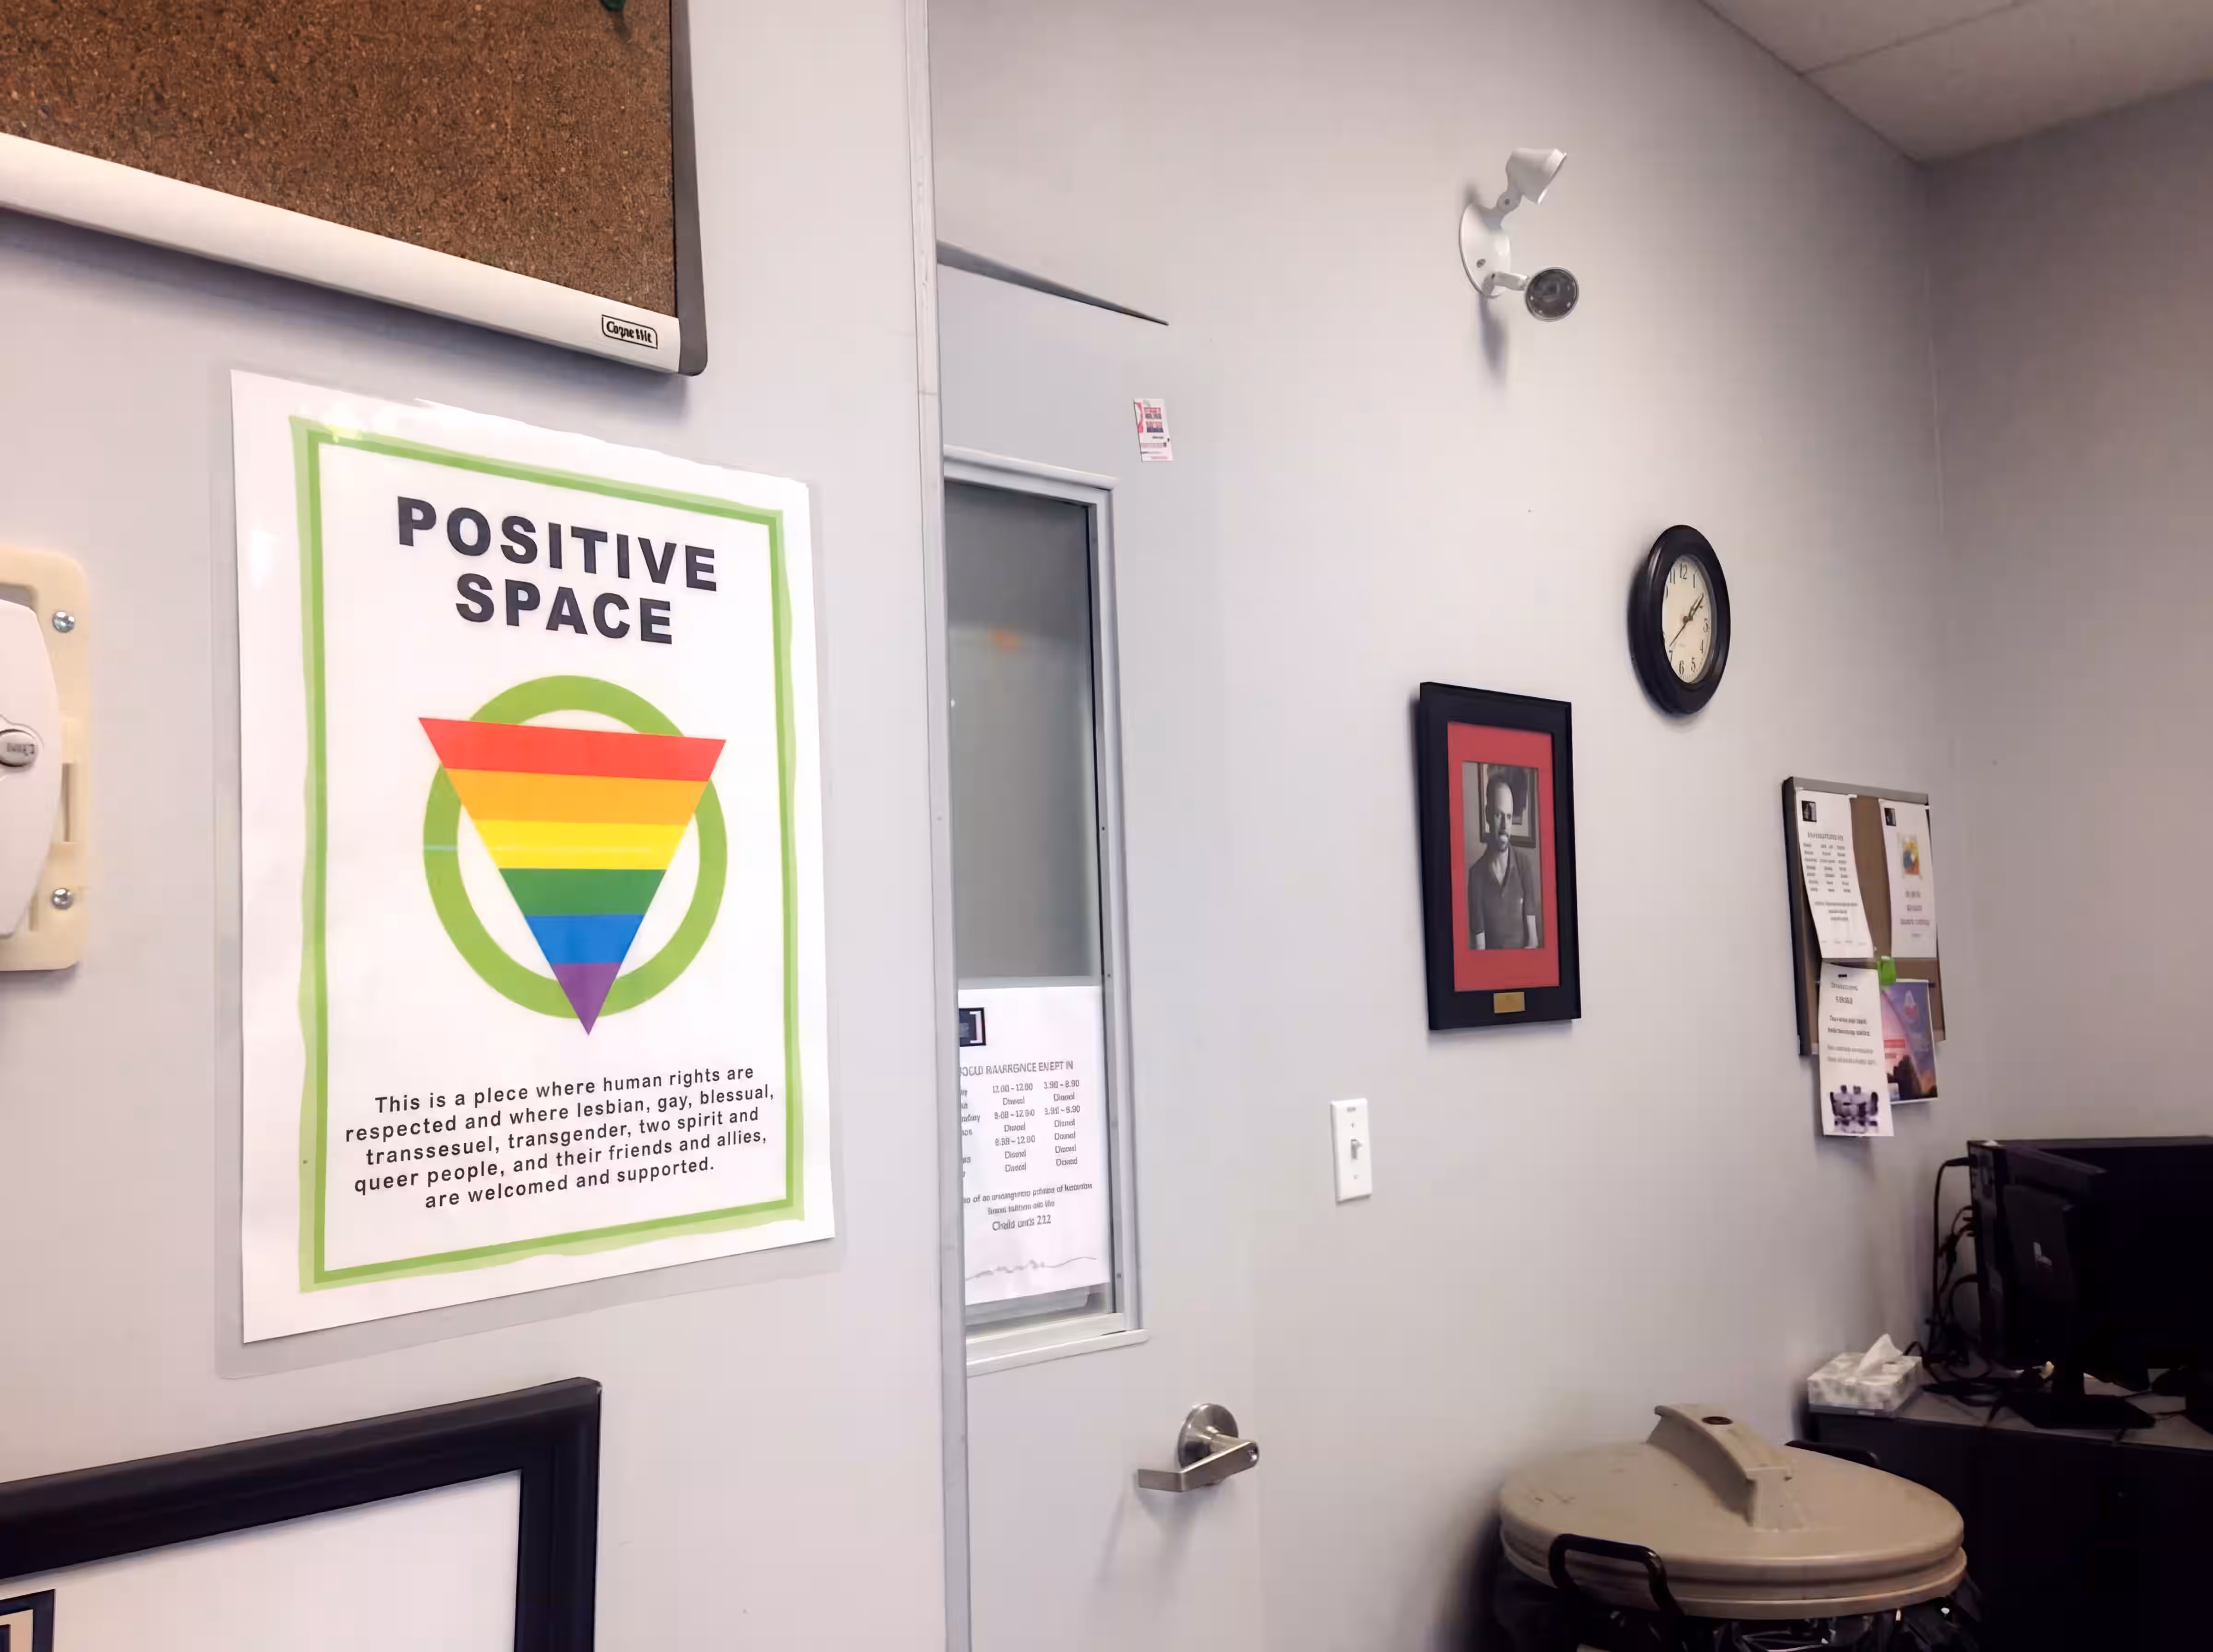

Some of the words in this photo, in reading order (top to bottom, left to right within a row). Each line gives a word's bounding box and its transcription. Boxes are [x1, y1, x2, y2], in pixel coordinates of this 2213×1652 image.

[398, 497, 716, 591] POSITIVE
[456, 573, 671, 644] SPACE
[375, 1095, 420, 1113] This
[430, 1092, 446, 1108] is
[455, 1094, 465, 1106] a
[536, 1081, 595, 1097] where
[604, 1076, 662, 1092] human
[670, 1068, 720, 1088] rights
[727, 1068, 753, 1080] are
[346, 1115, 456, 1143] respected
[465, 1110, 501, 1129] and
[509, 1108, 568, 1124] where
[578, 1098, 650, 1118] lesbian,
[658, 1096, 692, 1113] gay,
[508, 1123, 631, 1149] transgender,
[639, 1119, 670, 1133] two
[677, 1111, 723, 1133] spirit
[729, 1106, 758, 1123] and
[355, 1173, 419, 1196] queer
[428, 1161, 504, 1188] people,
[513, 1153, 547, 1172] and
[556, 1148, 602, 1167] their
[609, 1139, 672, 1160] friends
[680, 1133, 710, 1151] and
[717, 1130, 766, 1146] allies,
[426, 1193, 459, 1208] are
[468, 1174, 567, 1203] welcomed
[576, 1169, 609, 1188] and
[617, 1156, 714, 1183] supported.
